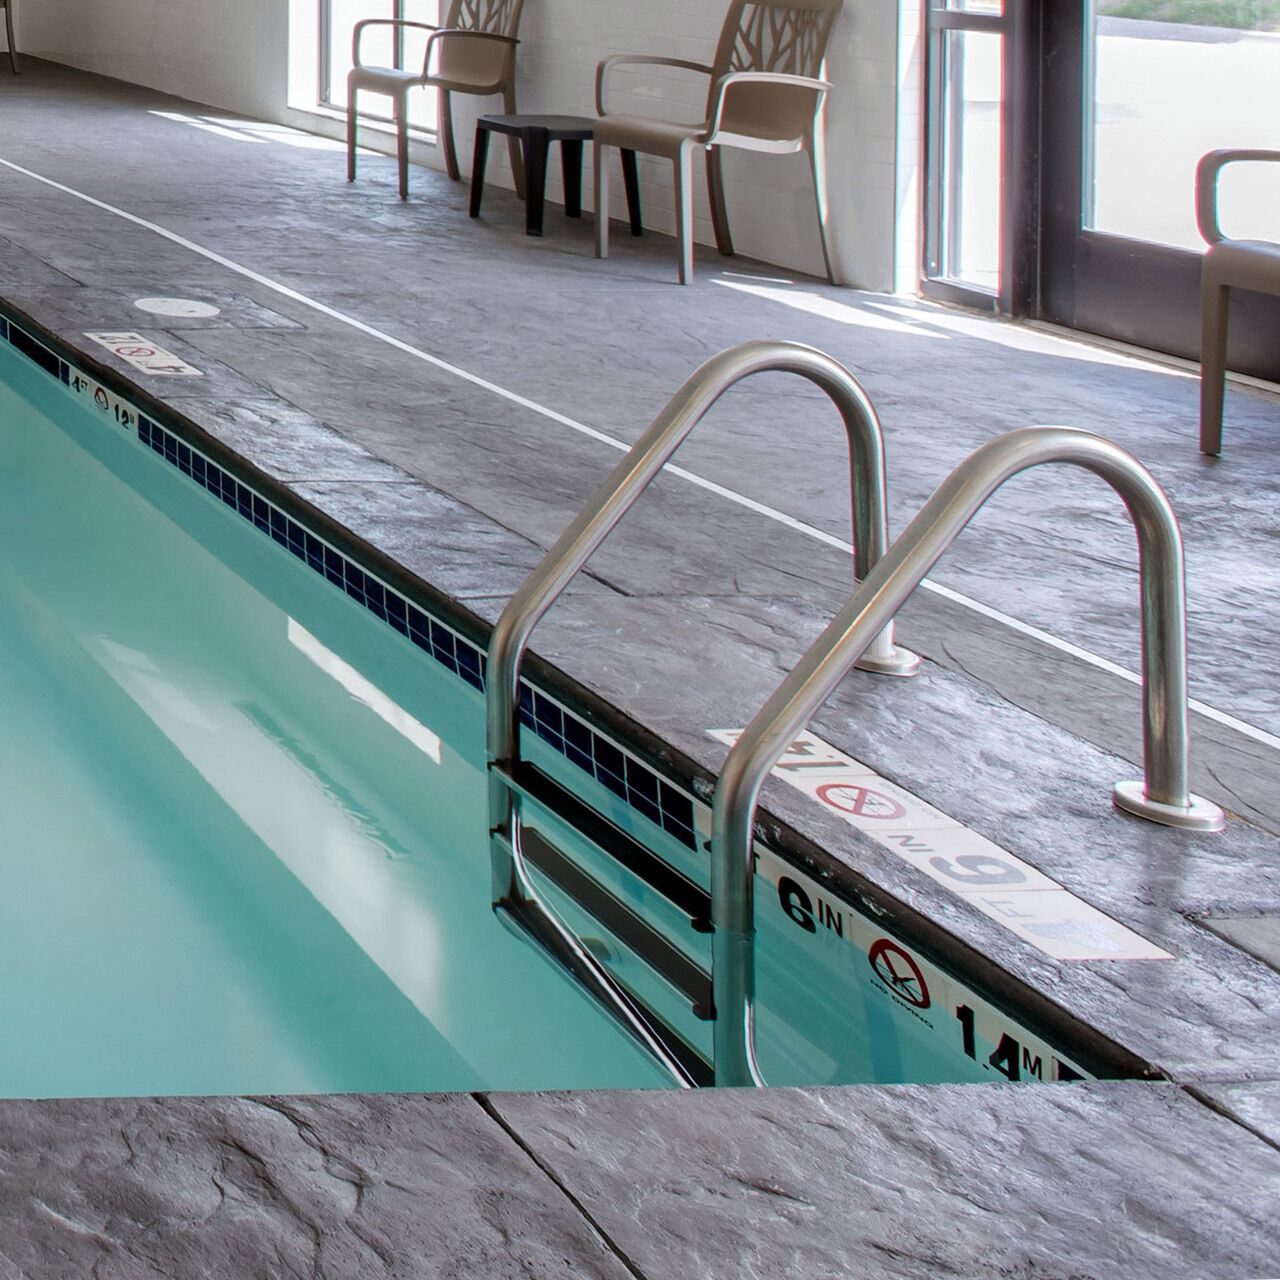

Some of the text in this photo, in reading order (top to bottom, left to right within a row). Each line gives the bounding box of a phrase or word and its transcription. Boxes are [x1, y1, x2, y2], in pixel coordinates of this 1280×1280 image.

[929, 855, 1028, 885] 6
[777, 876, 817, 934] 6
[817, 897, 844, 938] IN
